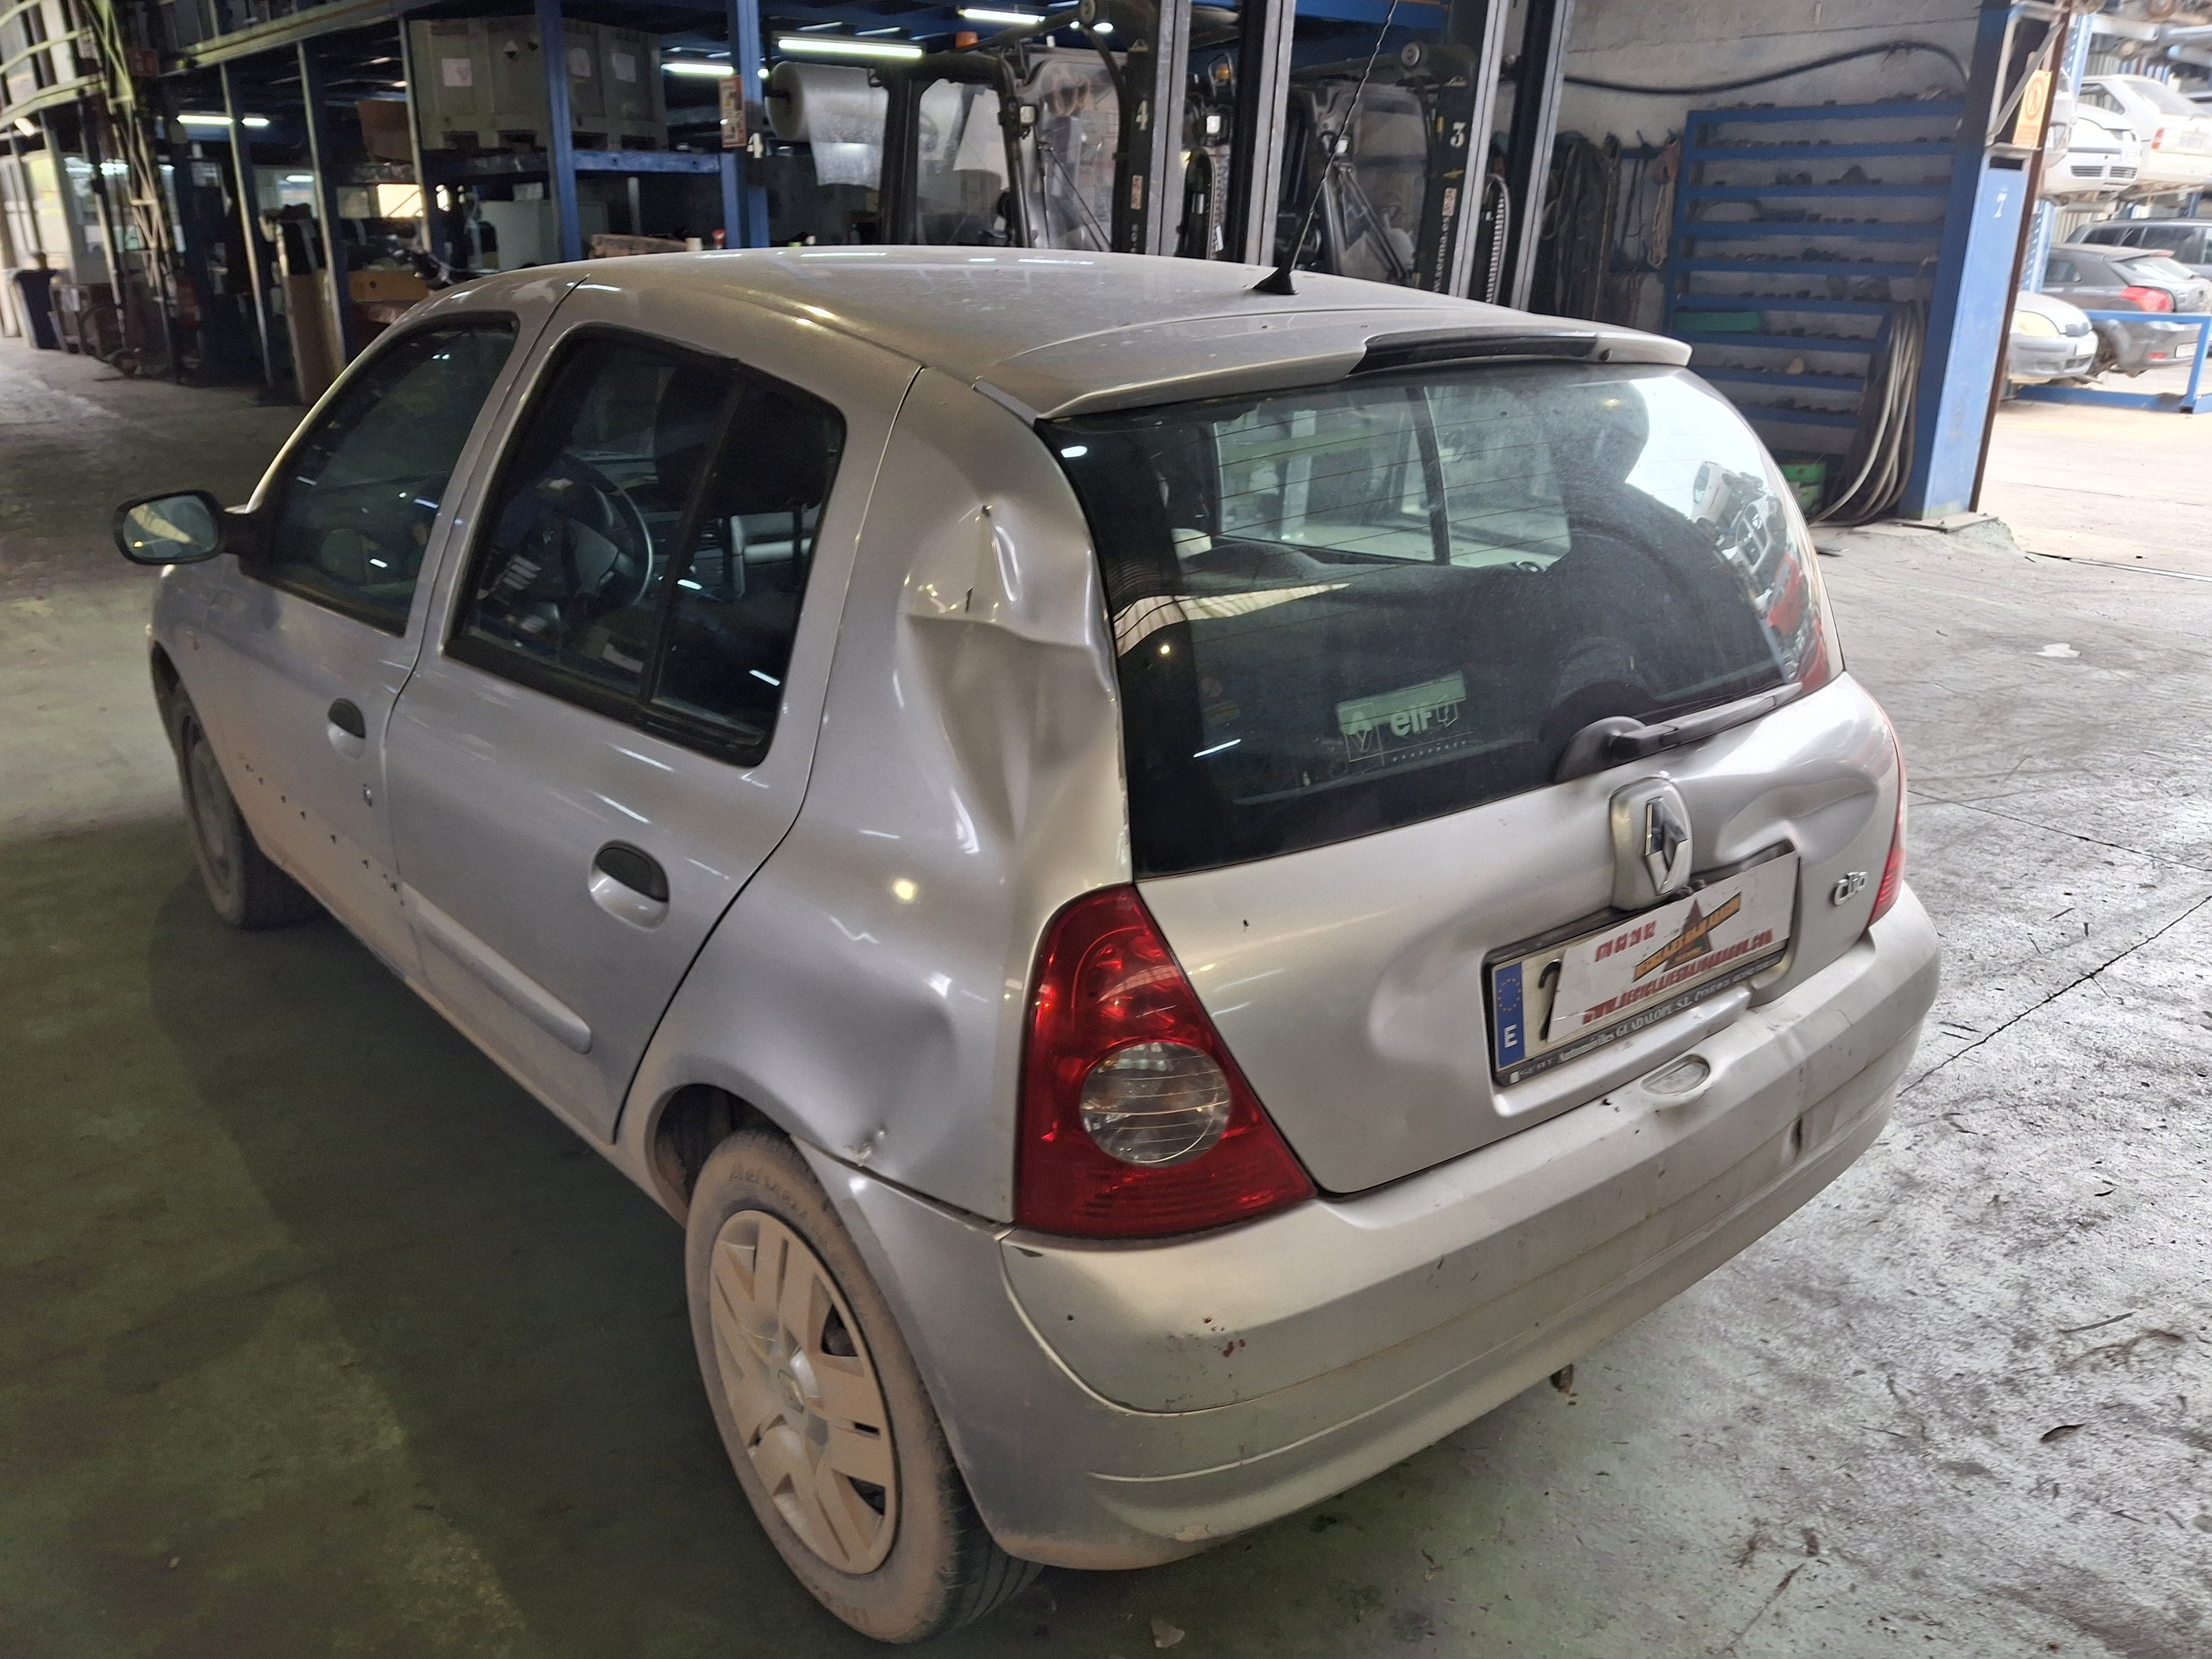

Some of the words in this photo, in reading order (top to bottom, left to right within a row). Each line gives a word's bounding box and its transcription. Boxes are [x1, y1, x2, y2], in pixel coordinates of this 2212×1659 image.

[1135, 100, 1148, 130] 4
[1450, 121, 1466, 147] 3
[1390, 702, 1433, 737] elf
[1504, 1024, 1518, 1049] E
